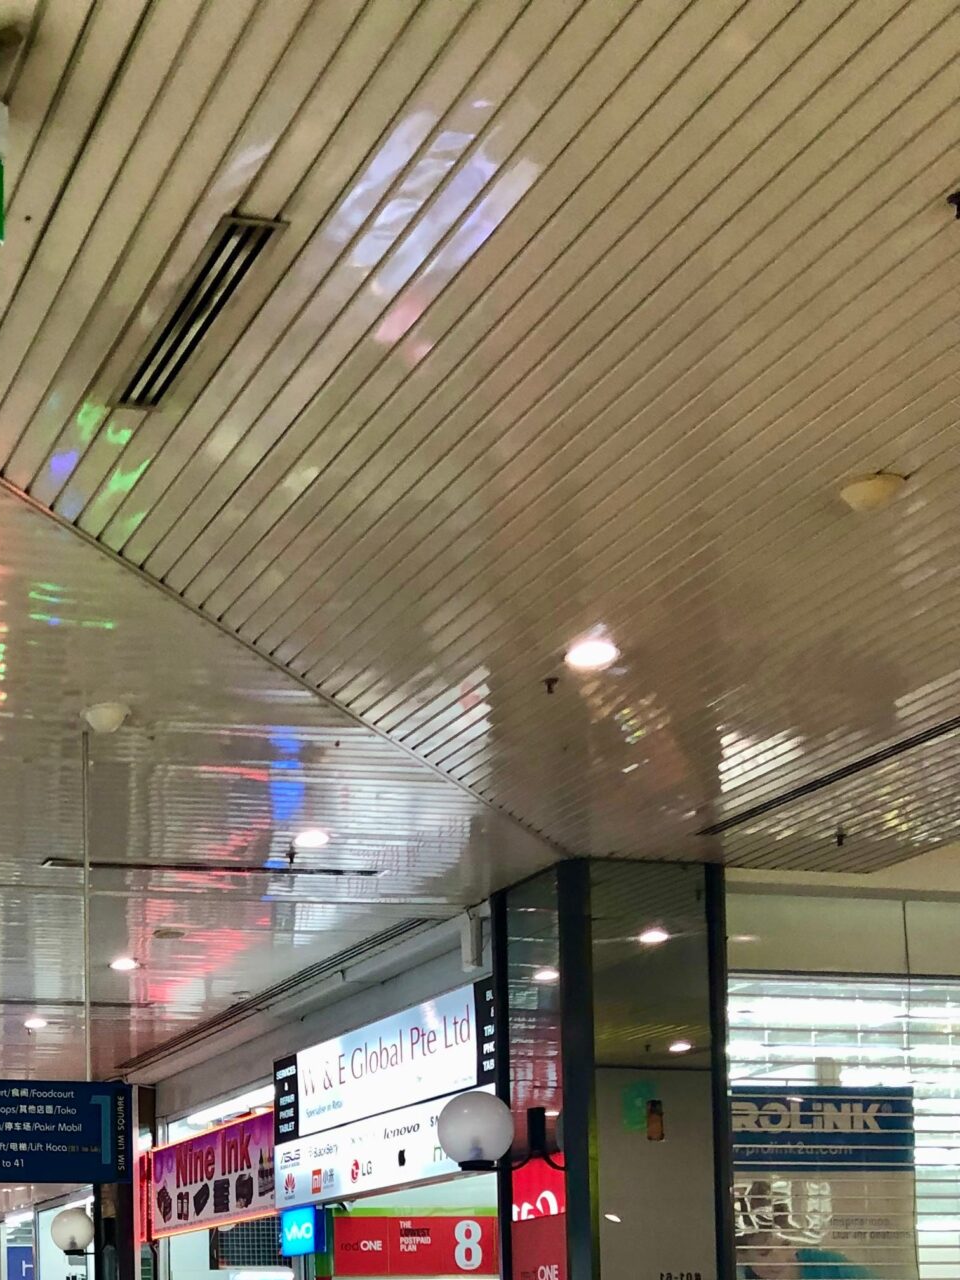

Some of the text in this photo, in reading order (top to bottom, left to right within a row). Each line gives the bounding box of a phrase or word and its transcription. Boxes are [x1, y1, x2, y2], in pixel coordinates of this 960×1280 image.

[338, 1053, 347, 1086] E
[351, 1028, 404, 1080] Global
[409, 1025, 438, 1061] Pte
[443, 1004, 472, 1050] Ltd
[279, 1094, 295, 1106] REPAIR
[279, 1108, 295, 1120] PHONE
[57, 1122, 82, 1132] Mobil
[117, 1095, 126, 1171] SIM LIM SQUARE
[279, 1121, 296, 1134] TABLET
[2, 1158, 12, 1168] to
[14, 1158, 25, 1168] 41
[176, 1127, 252, 1189] Nine Ink
[361, 1161, 373, 1177] LG
[284, 1220, 314, 1239] vivo
[399, 1220, 412, 1228] THE
[400, 1237, 431, 1245] POSTPAID
[454, 1220, 483, 1270] 8
[400, 1244, 417, 1252] PLAN
